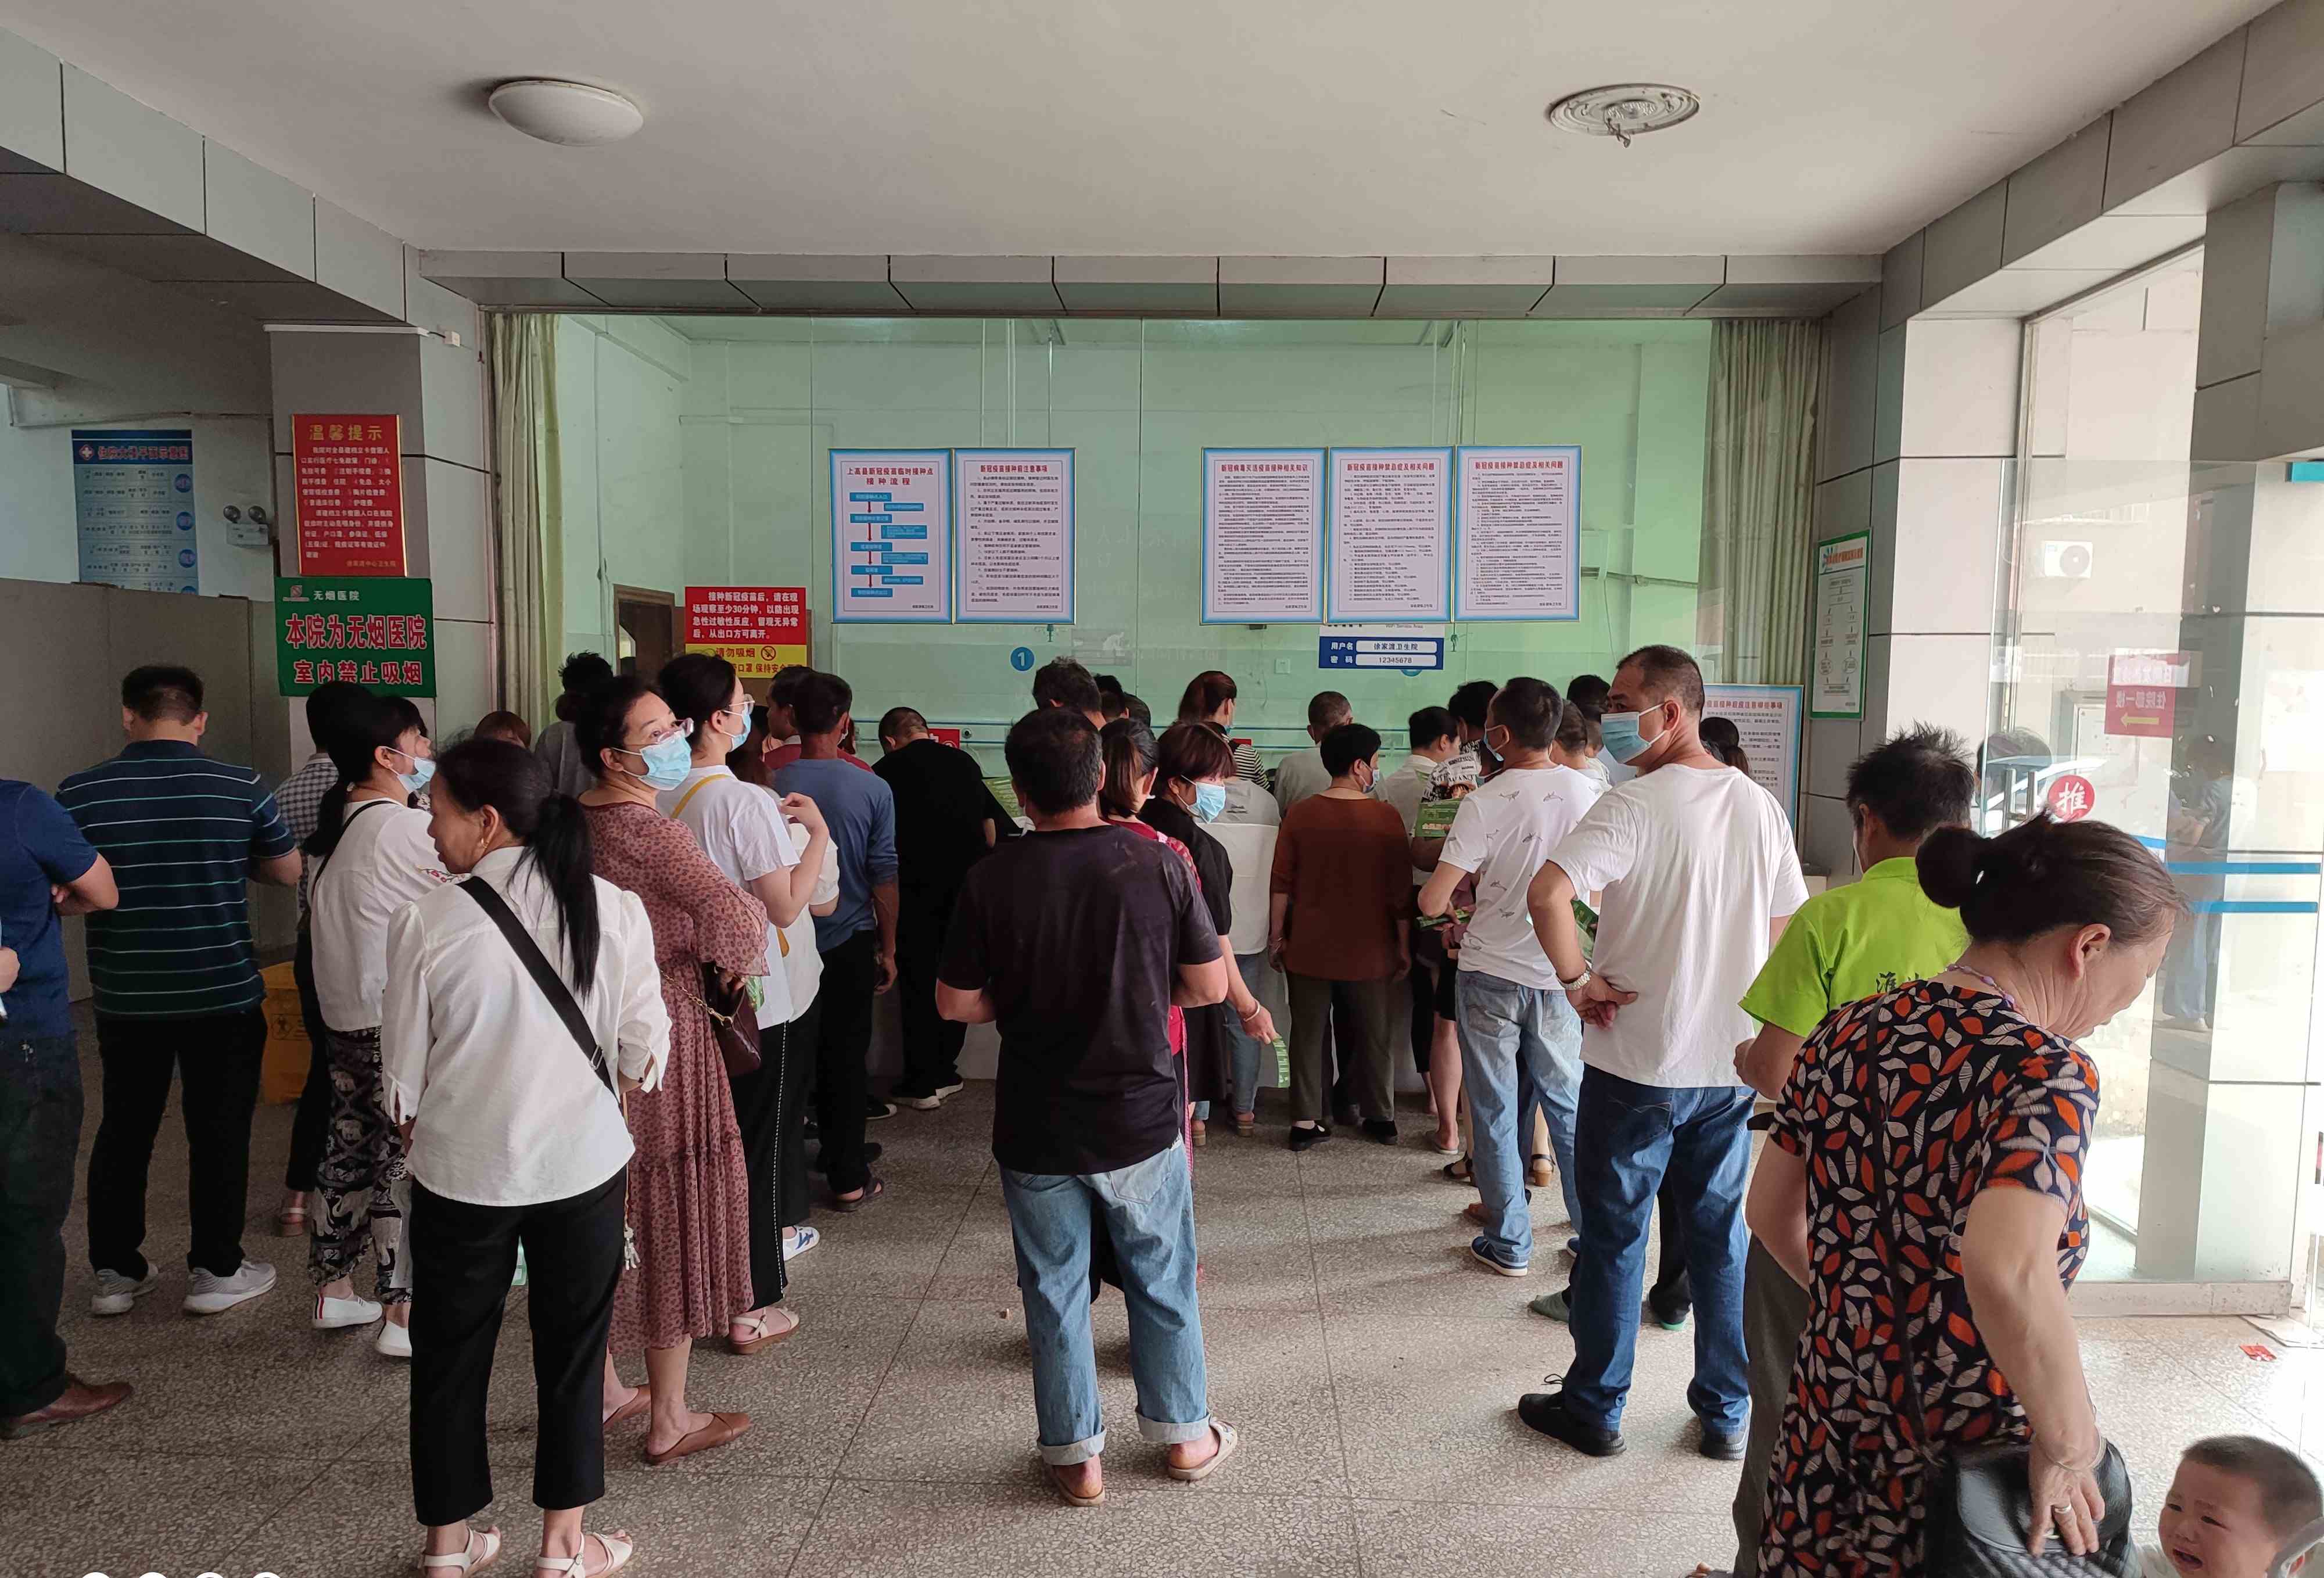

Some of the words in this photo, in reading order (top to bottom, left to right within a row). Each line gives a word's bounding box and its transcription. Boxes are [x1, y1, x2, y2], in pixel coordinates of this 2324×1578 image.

[309, 424, 382, 440] 温馨提示
[847, 467, 934, 476] 上高县新冠疫苗临时接种点
[866, 477, 912, 486] 接种流程
[313, 590, 360, 601] 无烟医院
[285, 612, 428, 651] 本院为无烟医院
[1330, 641, 1354, 651] 用户名
[1373, 642, 1418, 651] 徐家渡卫生院
[715, 647, 756, 658] 请勿吸烟
[1017, 651, 1025, 667] 1
[1330, 655, 1354, 664] 密码
[293, 659, 423, 685] 室内禁止吸烟
[2056, 781, 2088, 815] 推
